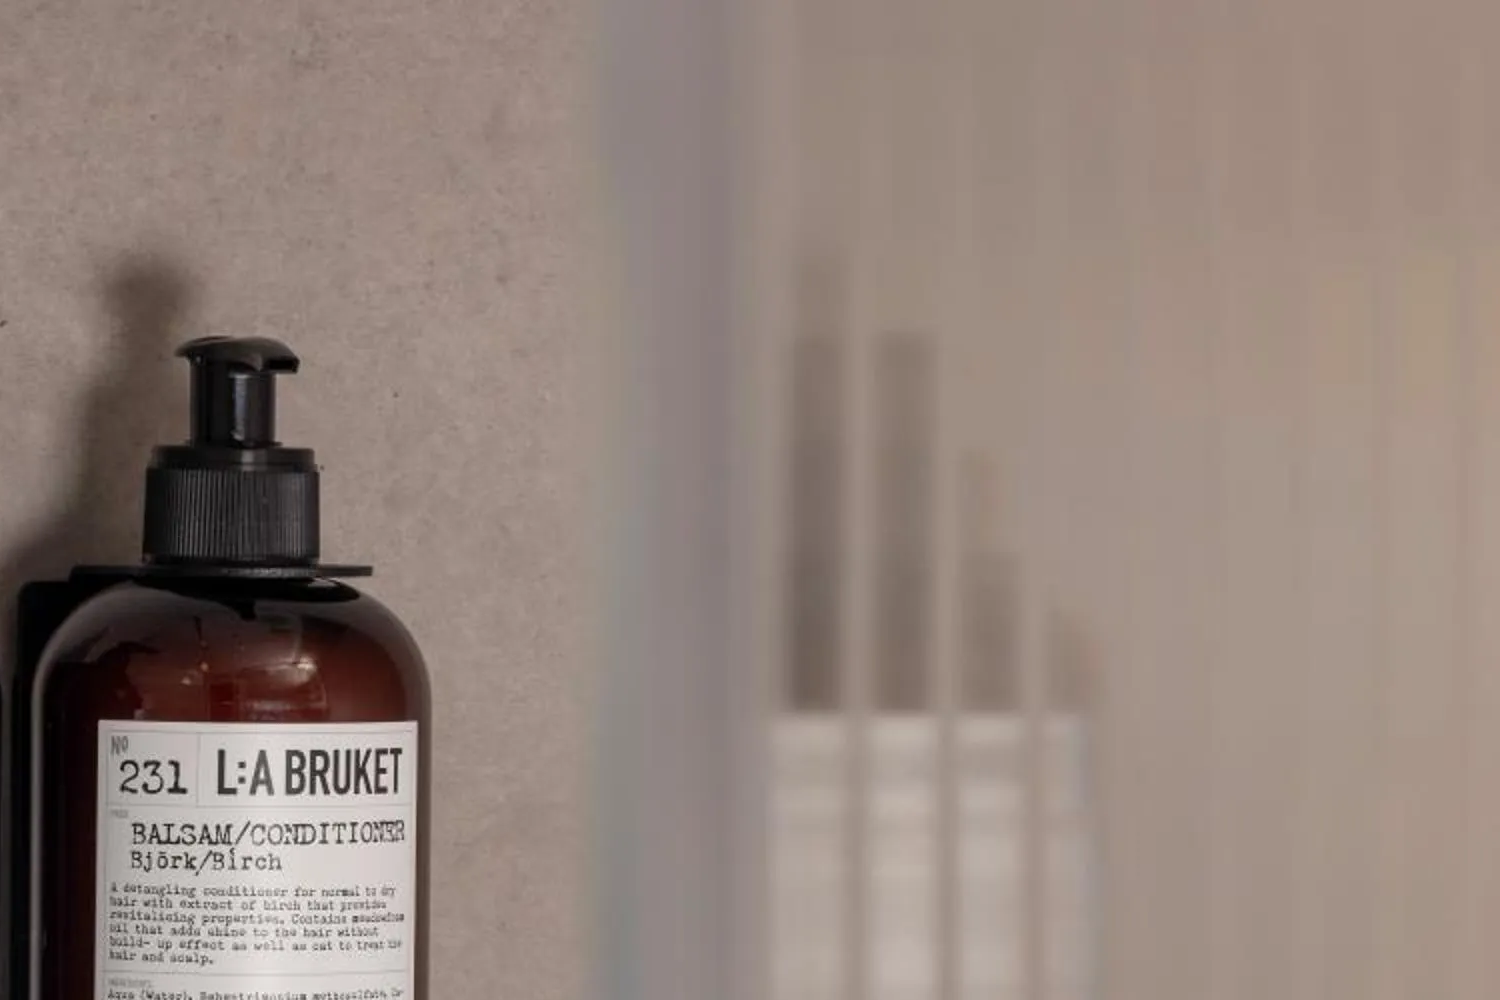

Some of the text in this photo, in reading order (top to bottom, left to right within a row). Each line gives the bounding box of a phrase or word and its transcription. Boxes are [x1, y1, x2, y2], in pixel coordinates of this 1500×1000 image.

[120, 760, 187, 795] 231
[217, 748, 402, 796] L:A BRUKET
[132, 819, 404, 846] BALSAM/CONDITIONER
